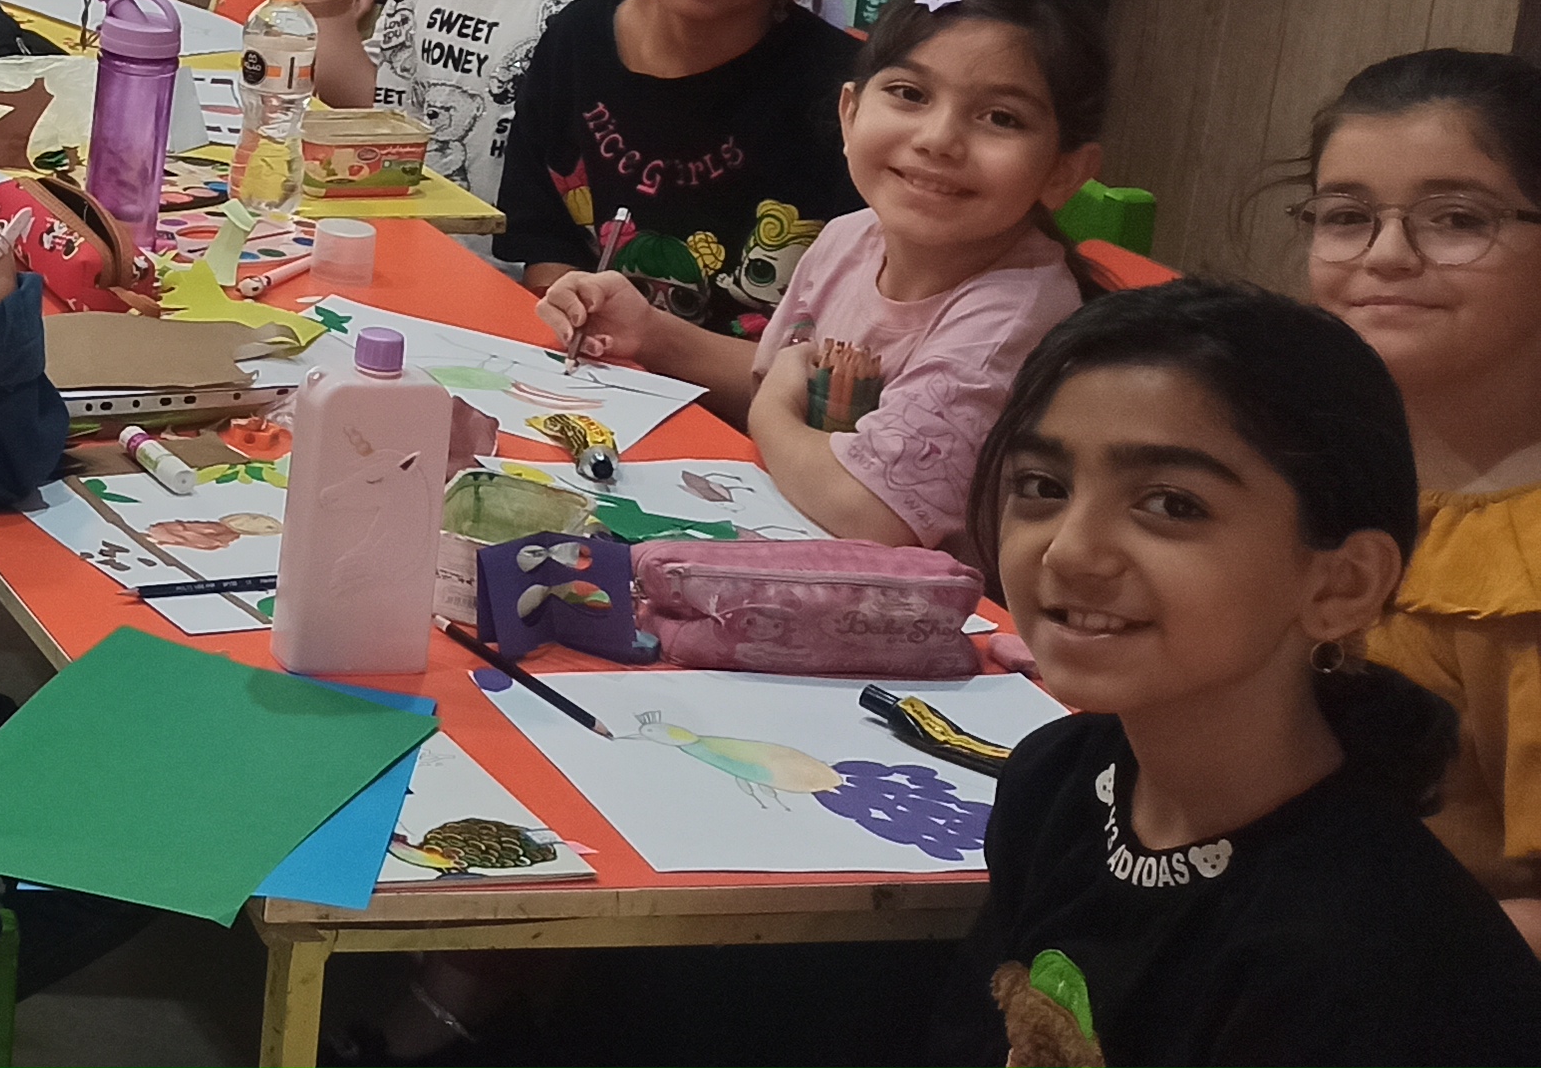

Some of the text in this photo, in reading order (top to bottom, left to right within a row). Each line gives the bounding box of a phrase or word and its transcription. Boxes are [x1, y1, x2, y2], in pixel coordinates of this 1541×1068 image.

[426, 7, 500, 44] SWEET
[421, 38, 489, 78] HONEY
[373, 87, 406, 107] EET
[1106, 843, 1190, 888] ADIDAS
